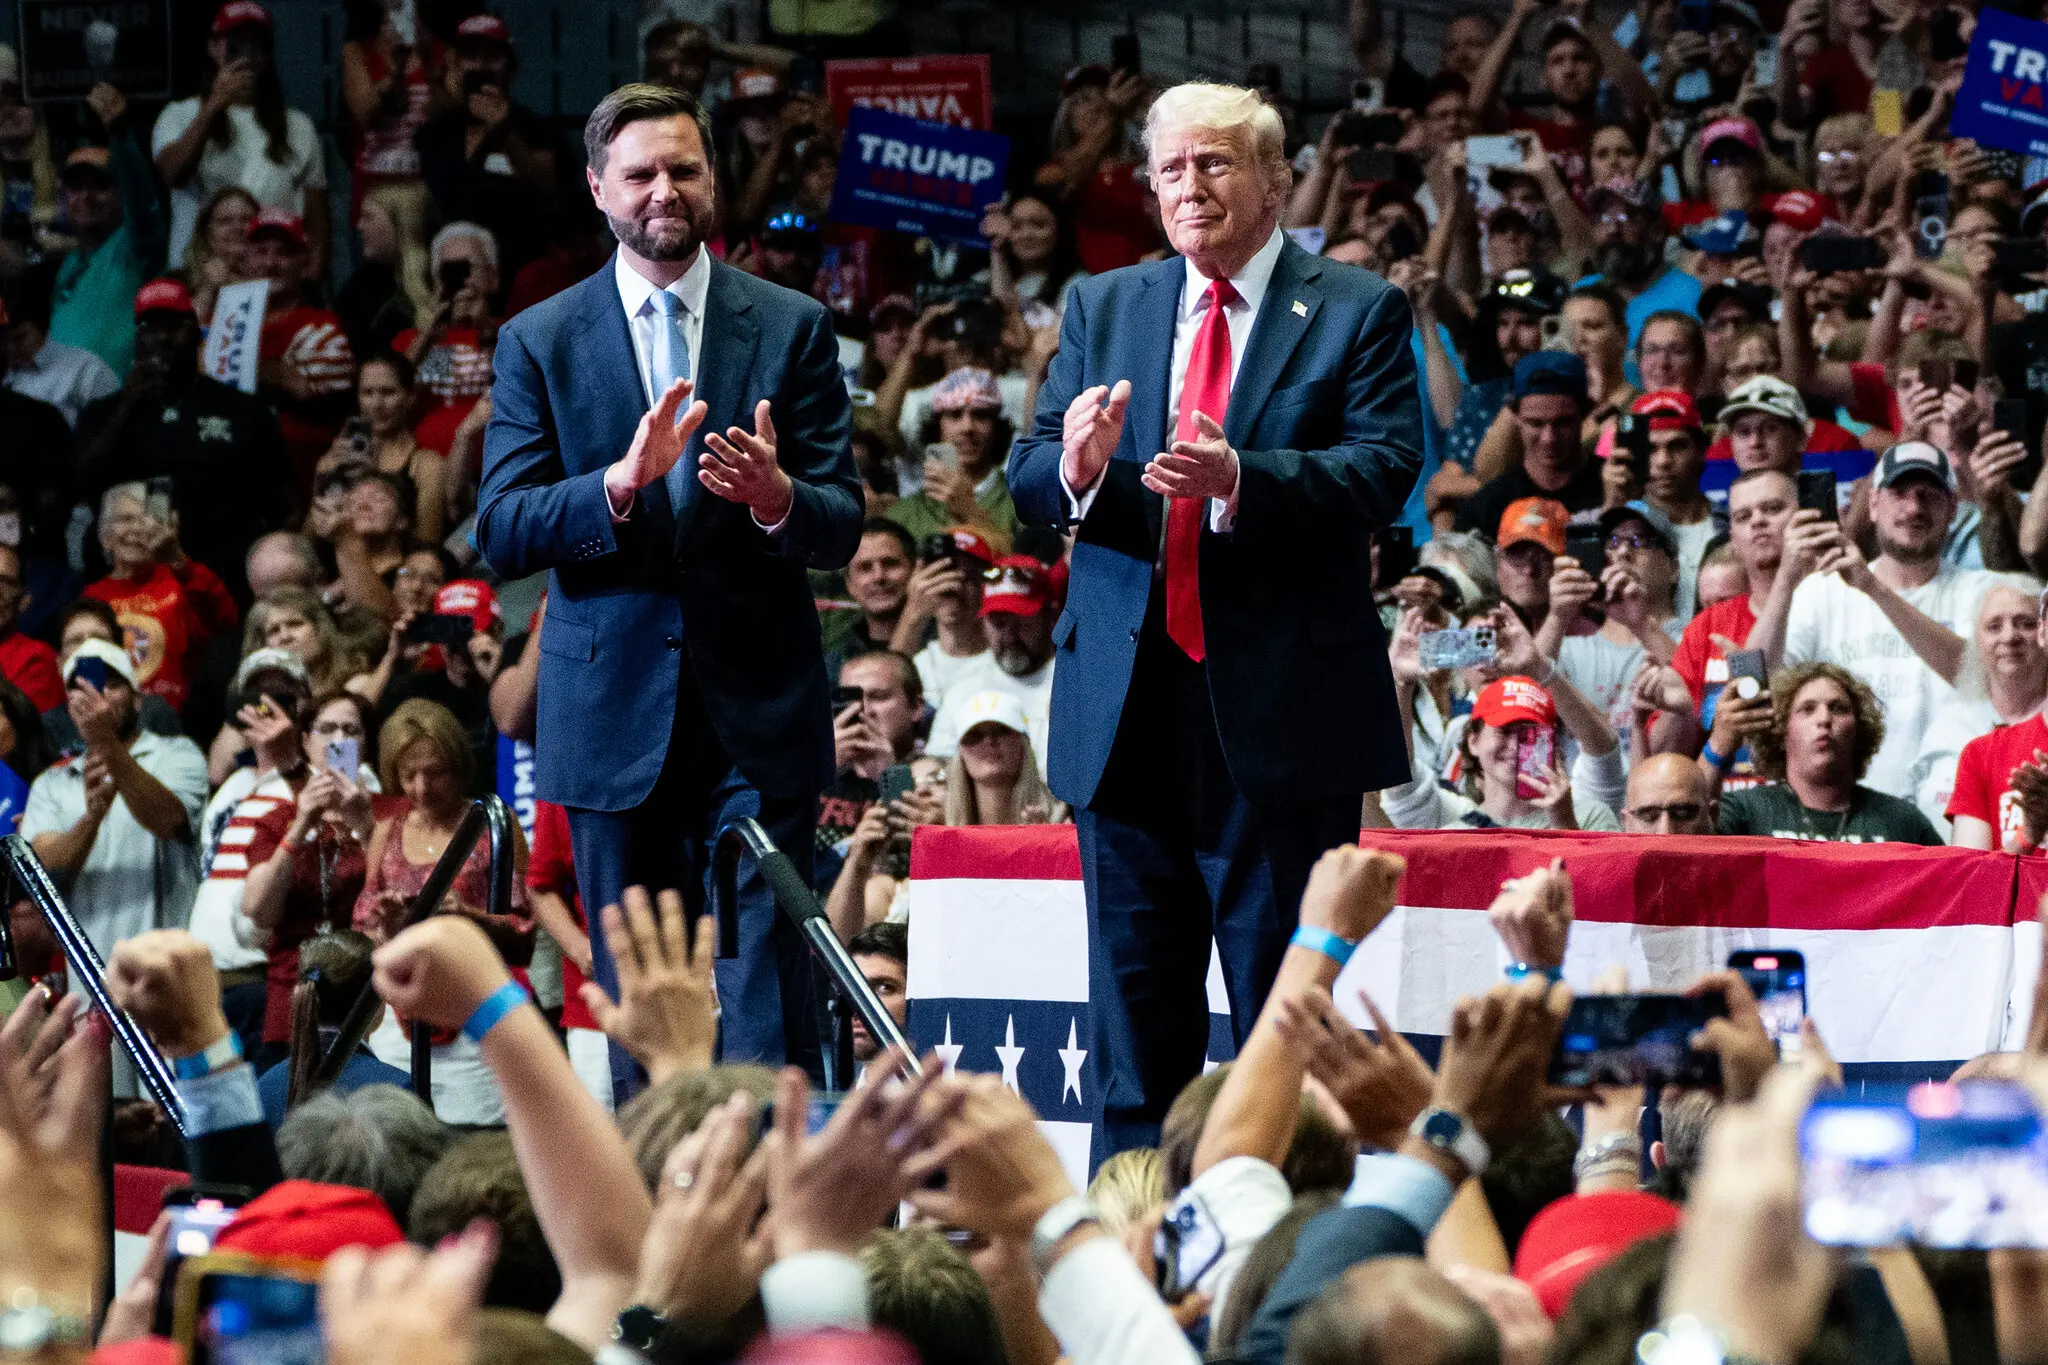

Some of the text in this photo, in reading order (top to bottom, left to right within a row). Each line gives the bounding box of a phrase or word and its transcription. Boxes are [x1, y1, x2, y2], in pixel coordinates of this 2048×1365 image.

[1988, 39, 2048, 83] TR
[2002, 76, 2048, 110] VA
[858, 133, 995, 185] TRUMP
